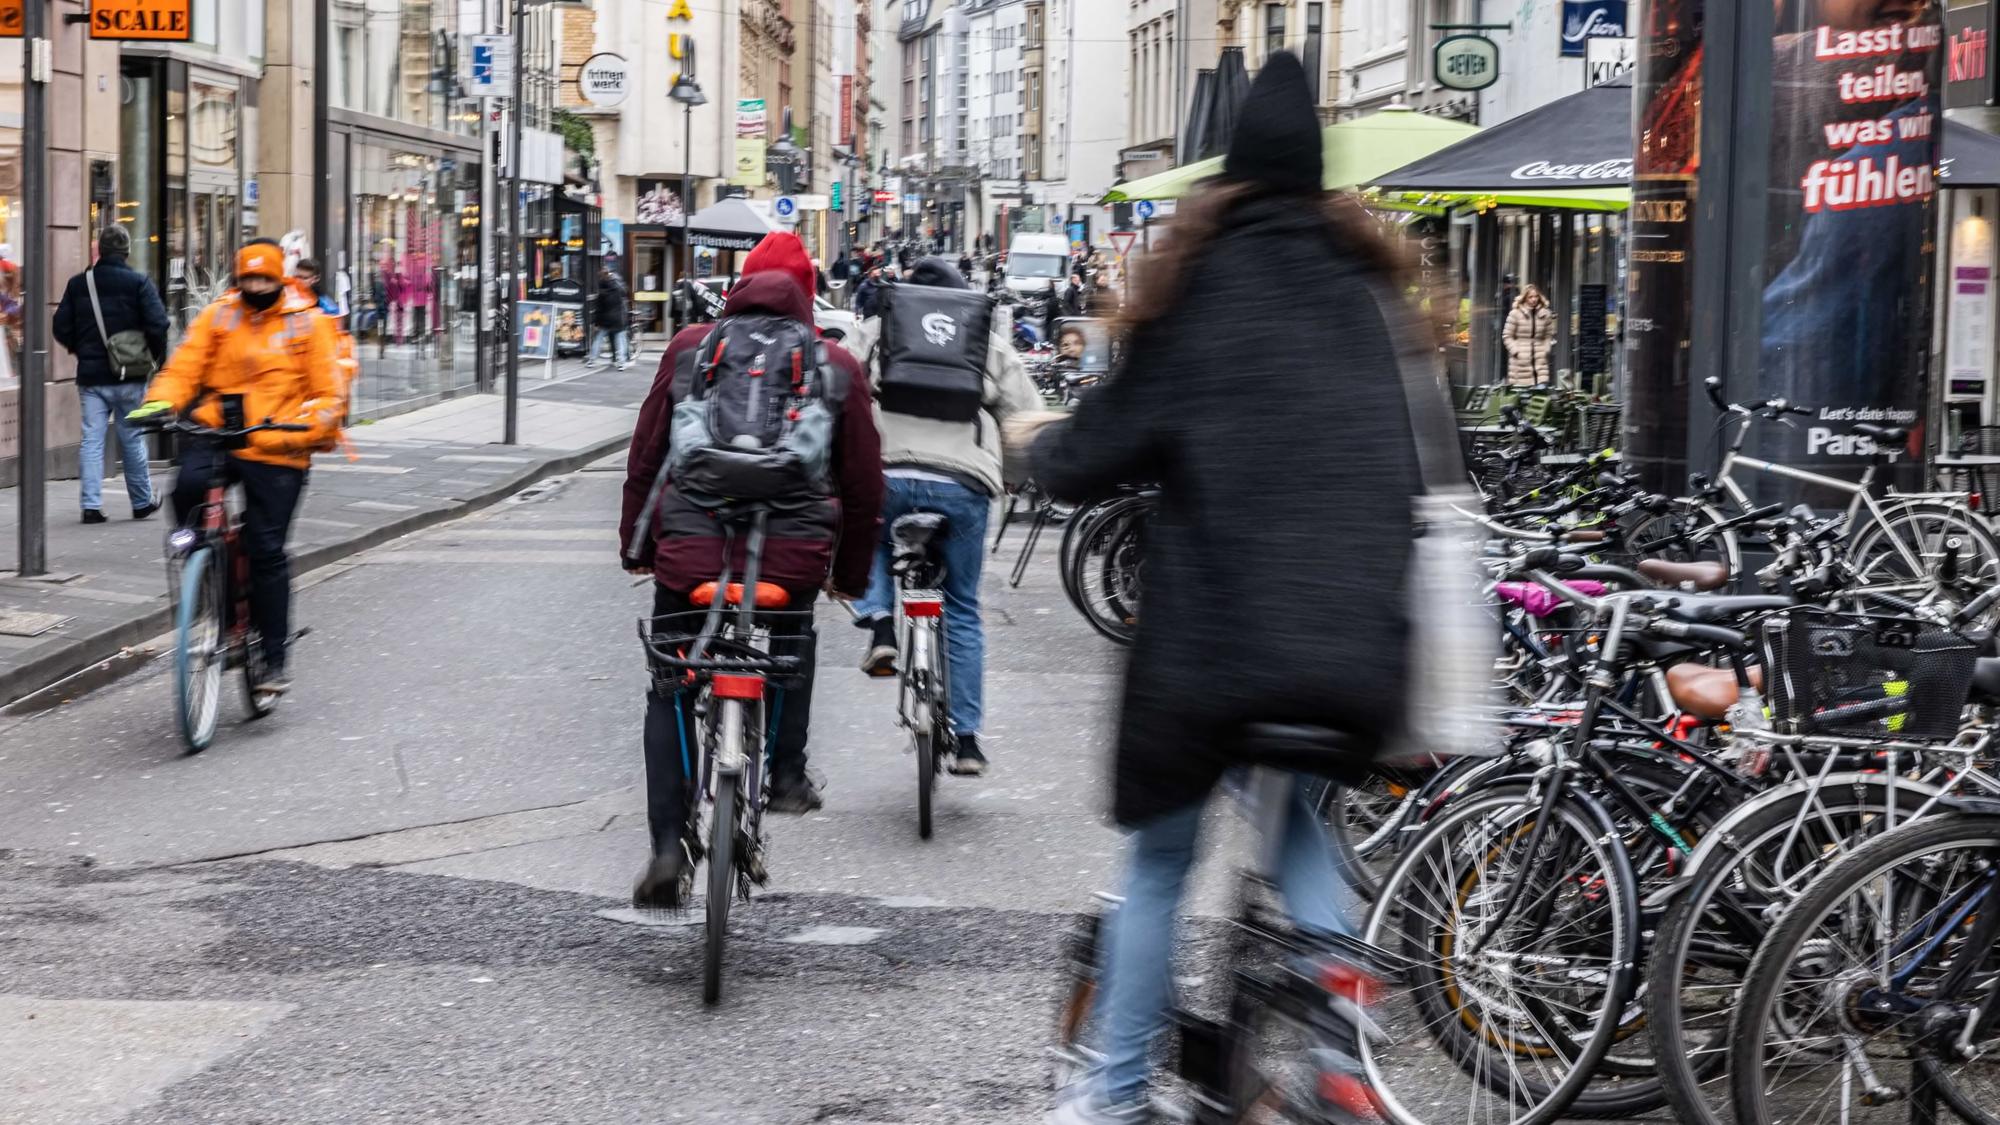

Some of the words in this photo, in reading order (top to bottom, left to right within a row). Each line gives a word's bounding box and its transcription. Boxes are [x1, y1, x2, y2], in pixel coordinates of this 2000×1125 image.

[95, 9, 185, 31] SCALE
[1562, 8, 1625, 43] Sion
[1816, 23, 1903, 57] Lasst
[1907, 24, 1941, 50] uns
[587, 69, 626, 80] fritten
[591, 80, 623, 89] werk
[1590, 61, 1636, 85] KIO
[1838, 64, 1929, 101] teilen,
[1823, 117, 1893, 147] was
[1898, 107, 1935, 139] wir
[1819, 405, 1856, 421] Let's
[1856, 405, 1885, 421] date
